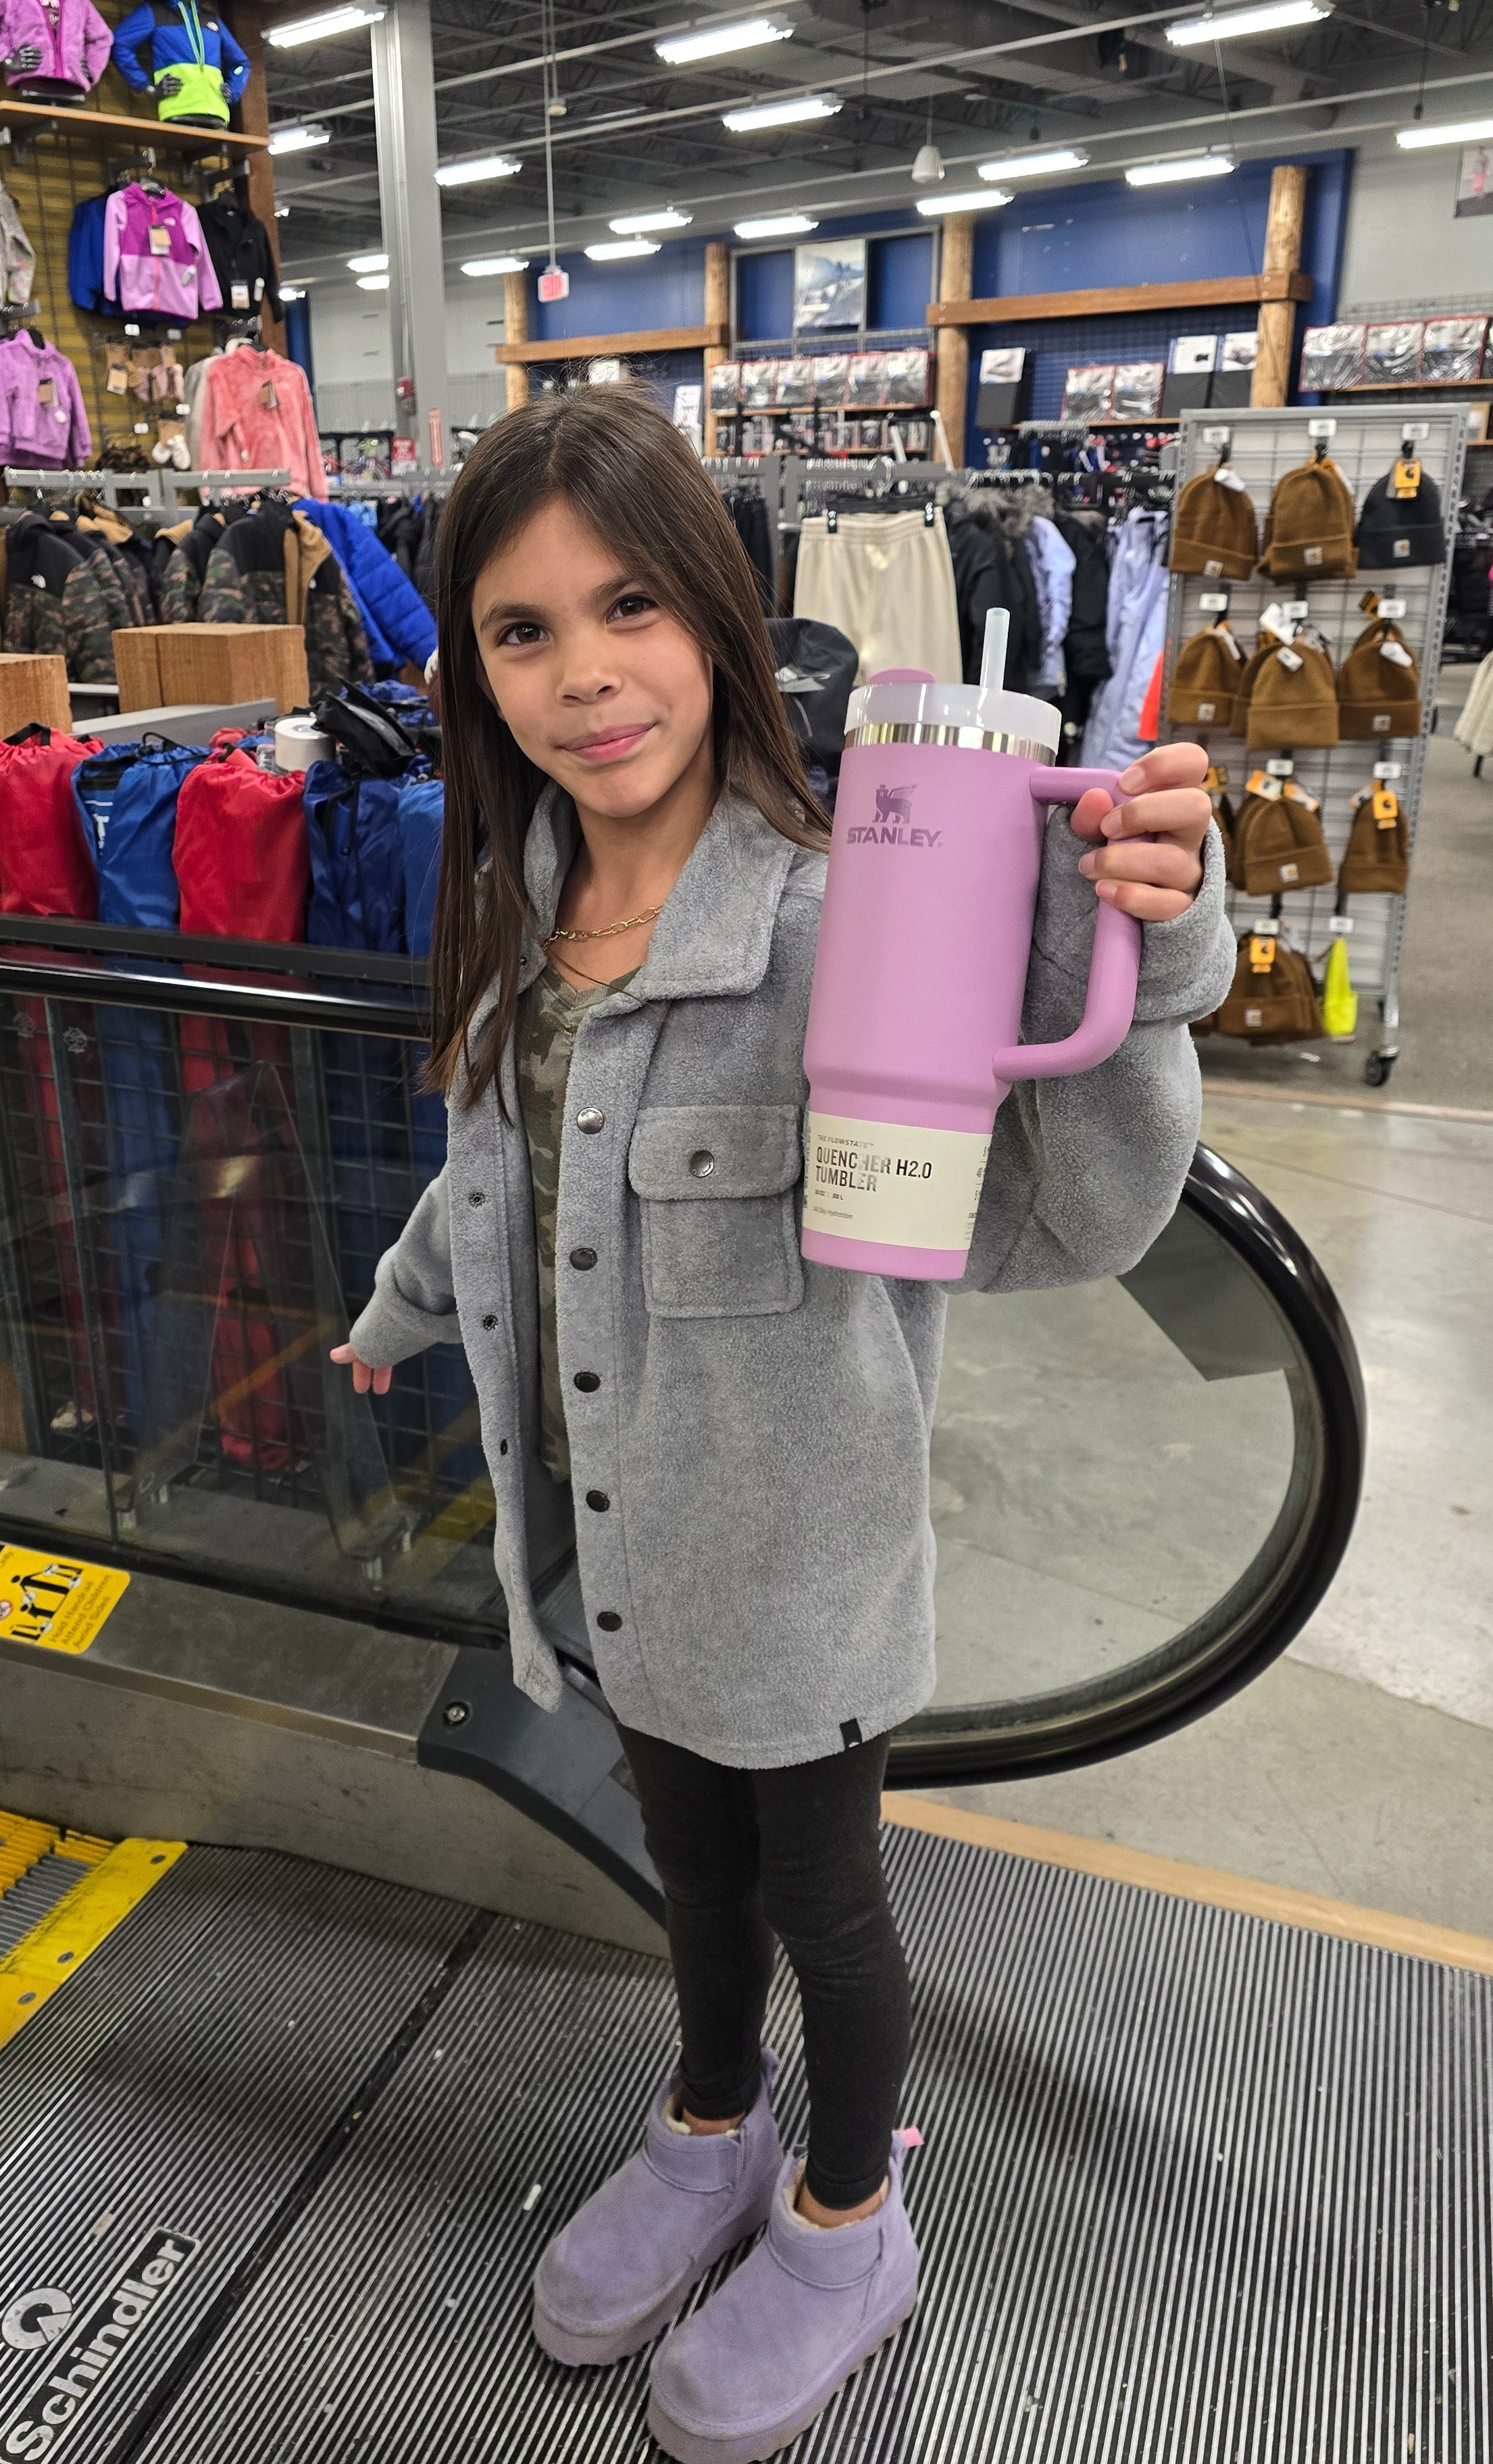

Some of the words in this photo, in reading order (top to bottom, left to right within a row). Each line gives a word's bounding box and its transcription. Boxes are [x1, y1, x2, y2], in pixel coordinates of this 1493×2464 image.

[846, 826, 942, 848] STANLEY
[816, 1146, 891, 1175] QUENCHER
[896, 1158, 932, 1179] H2.0
[815, 1165, 877, 1192] TUMBLER
[82, 1574, 110, 1612] Children
[89, 1597, 110, 1621] Sides
[5, 2238, 187, 2462] Schindler
